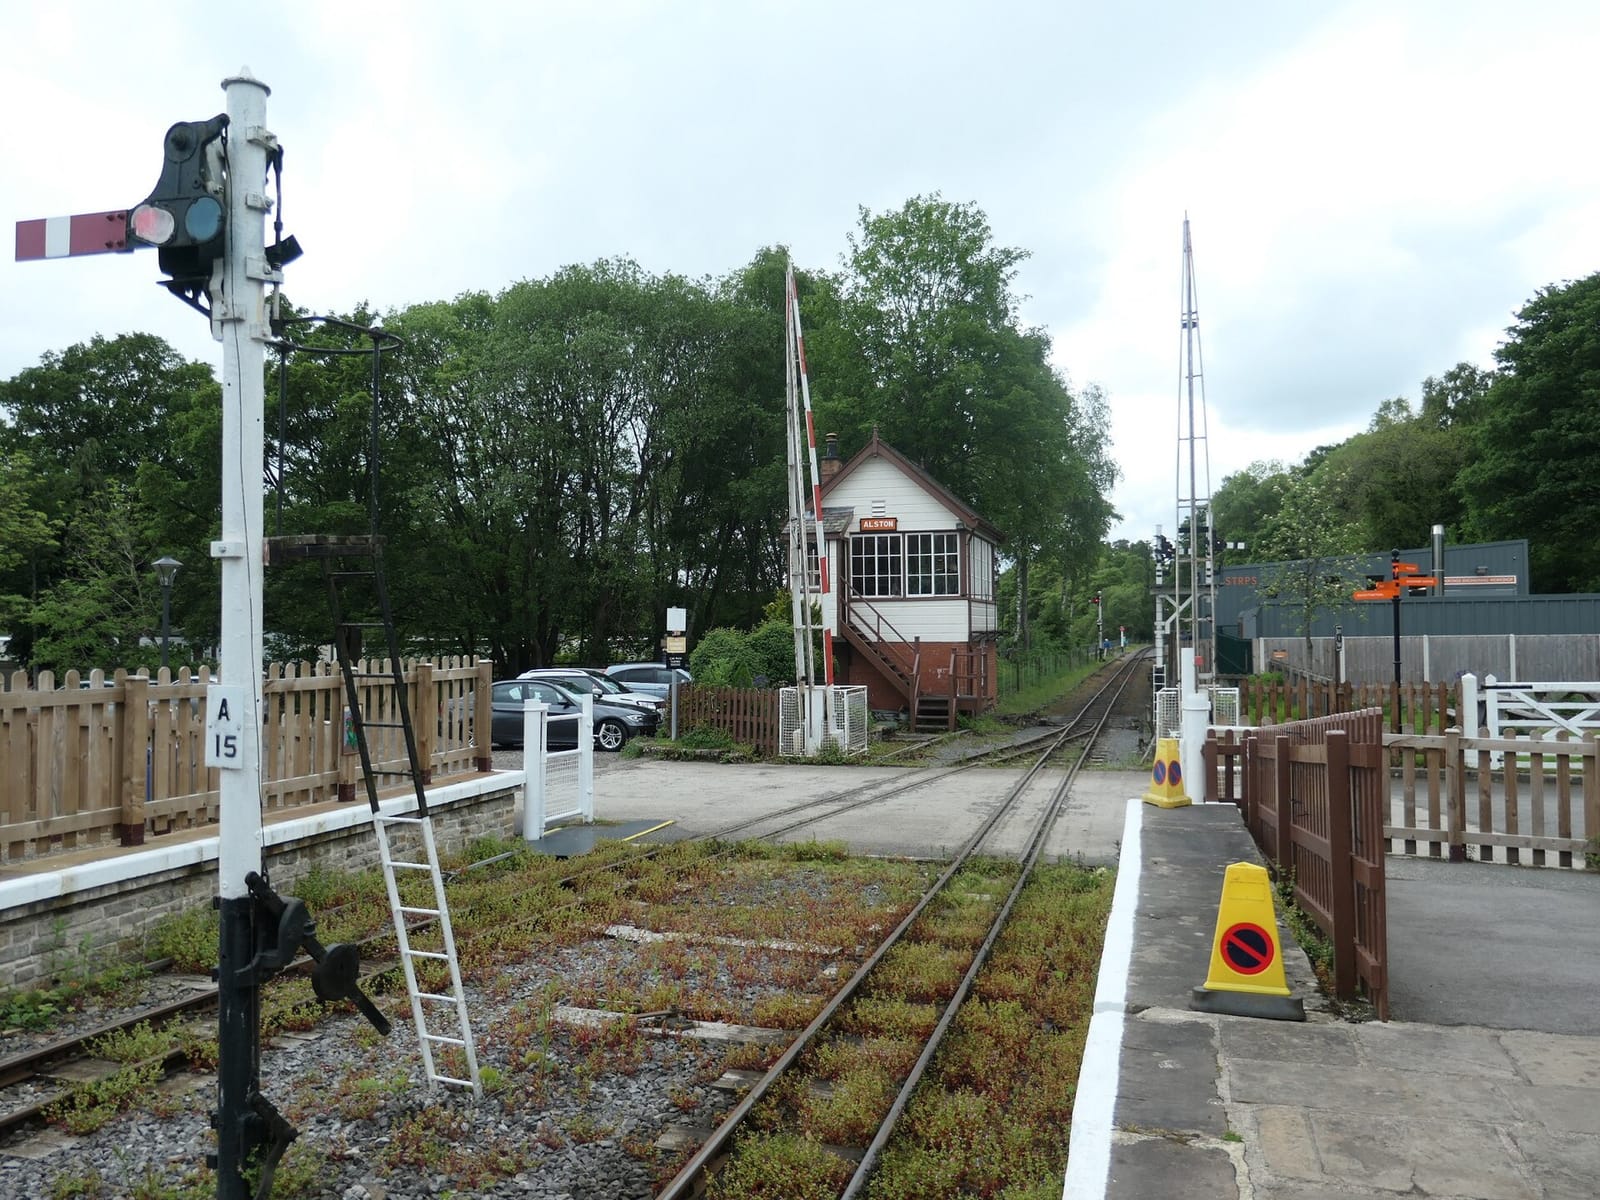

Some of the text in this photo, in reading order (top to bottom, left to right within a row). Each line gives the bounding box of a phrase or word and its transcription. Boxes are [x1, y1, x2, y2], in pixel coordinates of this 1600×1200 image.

[863, 520, 894, 528] ALSTON
[1225, 576, 1257, 586] STRPS
[218, 698, 230, 721] A
[216, 734, 237, 758] 15
